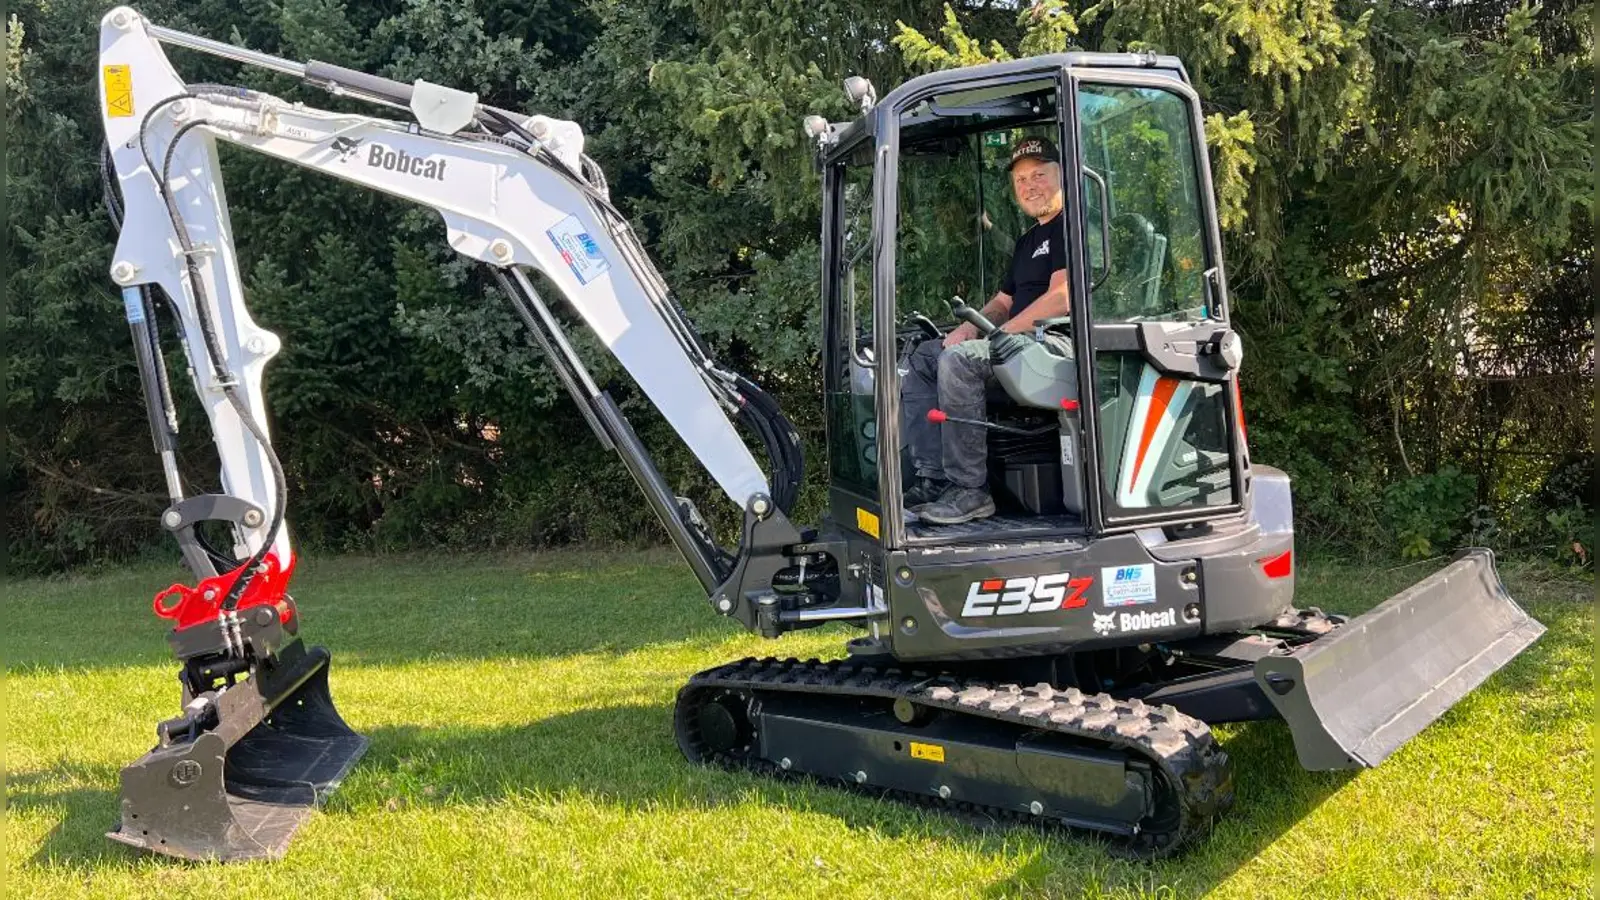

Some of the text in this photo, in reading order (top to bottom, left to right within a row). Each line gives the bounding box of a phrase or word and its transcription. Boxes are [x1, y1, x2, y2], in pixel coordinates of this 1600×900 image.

[367, 143, 447, 181] Bobcat
[1115, 567, 1144, 581] BHS
[1120, 607, 1176, 632] Bobcat
